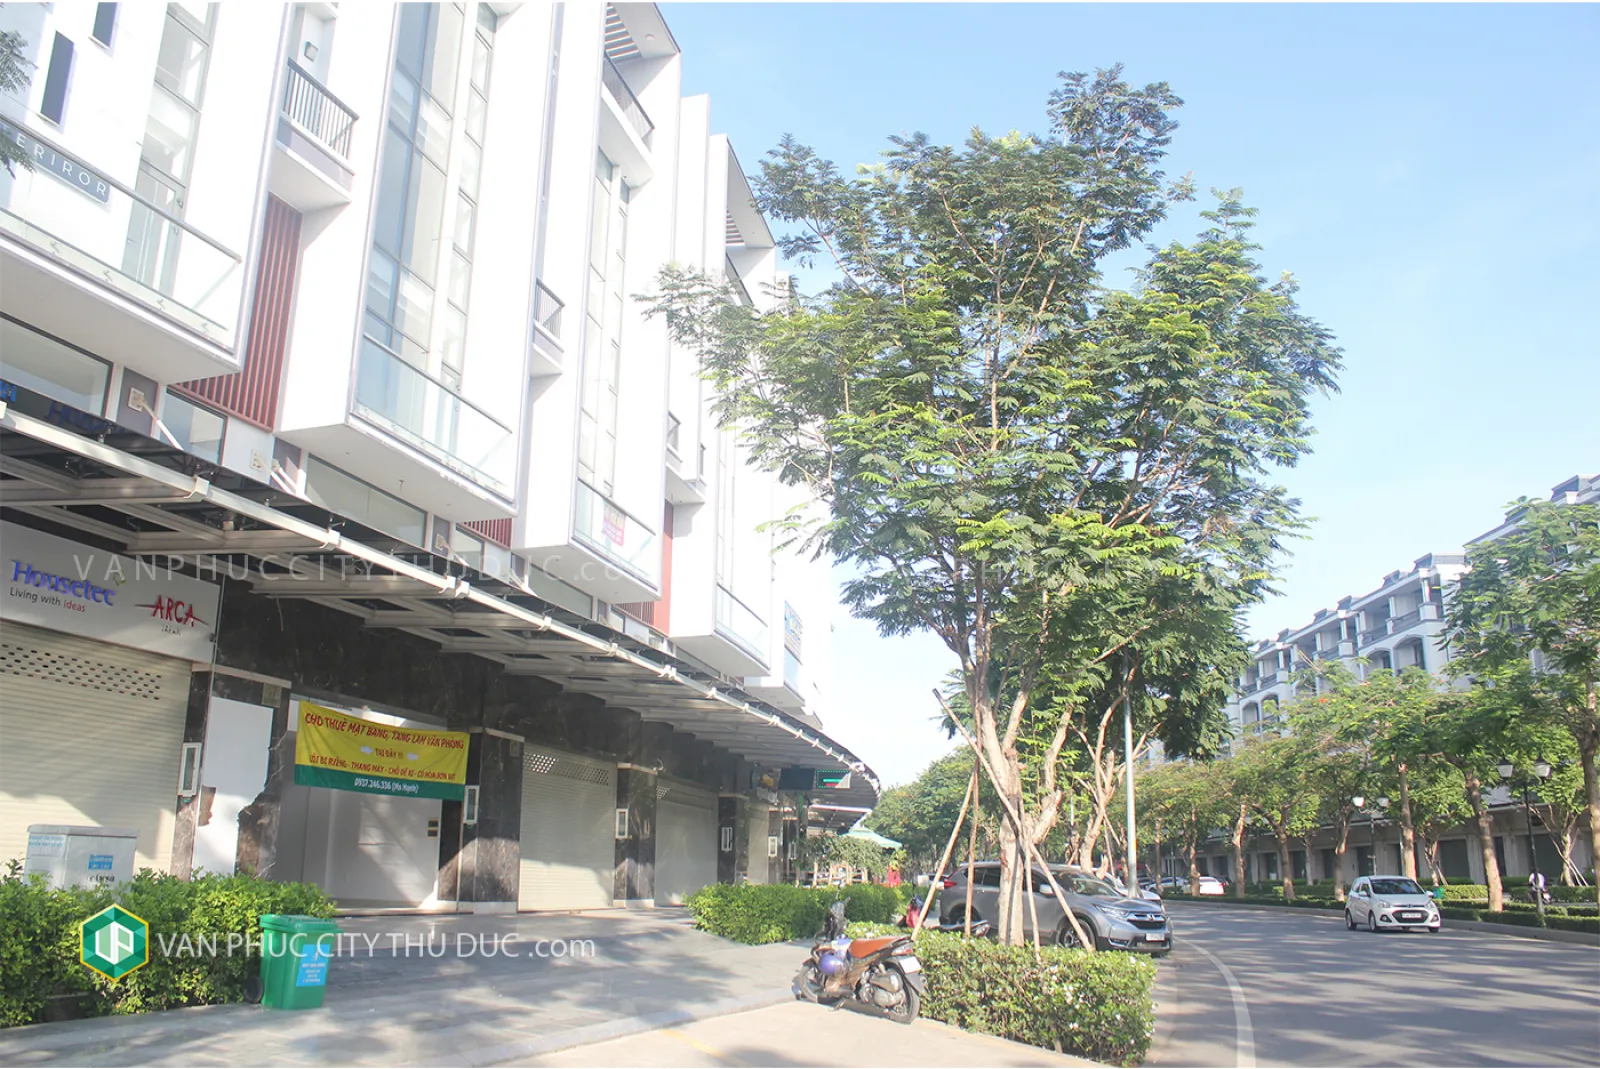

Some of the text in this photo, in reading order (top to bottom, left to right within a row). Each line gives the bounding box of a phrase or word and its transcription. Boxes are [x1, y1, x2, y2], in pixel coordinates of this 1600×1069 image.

[11, 558, 116, 606] Housetec
[9, 586, 86, 612] Living with ideas
[150, 595, 197, 627] ARCA
[305, 712, 323, 726] CHO
